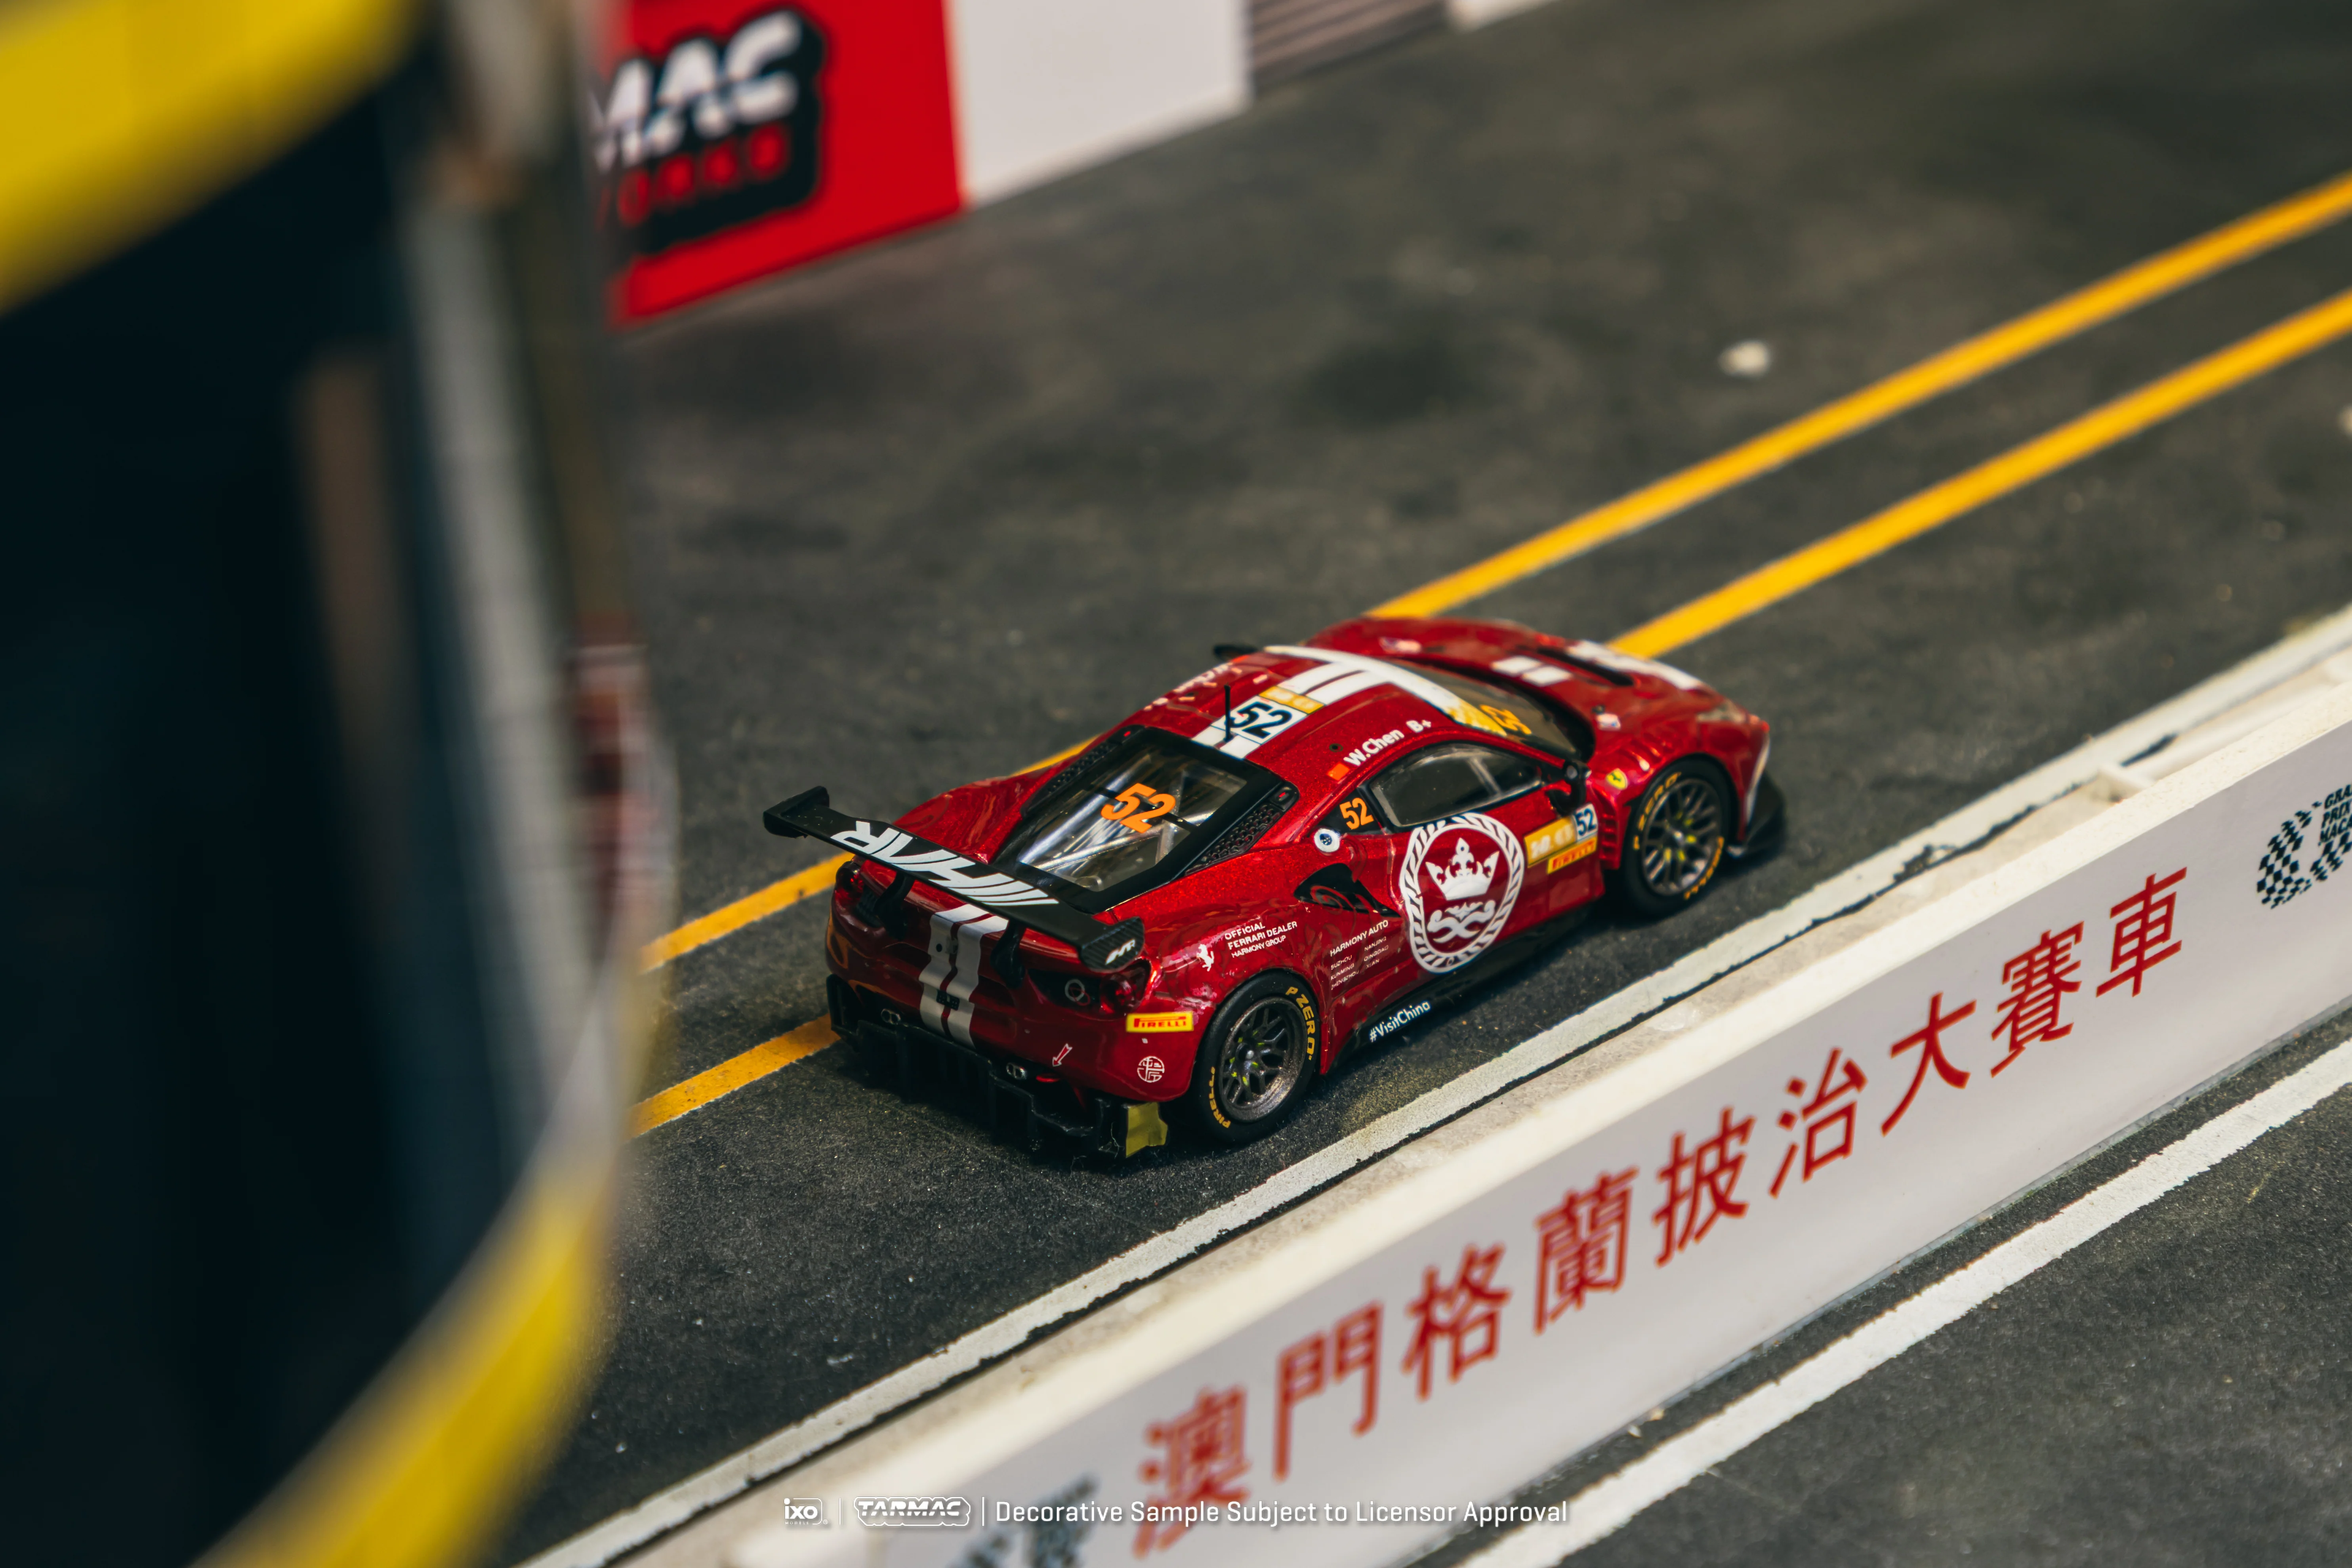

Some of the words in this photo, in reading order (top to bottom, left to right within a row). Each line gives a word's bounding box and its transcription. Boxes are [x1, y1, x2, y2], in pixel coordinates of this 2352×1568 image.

[1224, 701, 1292, 739] 52
[1343, 729, 1404, 766] W.Chen
[1101, 782, 1176, 834] 52
[1339, 797, 1374, 830] 52
[1574, 808, 1597, 836] 52
[1225, 922, 1265, 940] OFFICIAL
[1228, 932, 1266, 950] FERRARI
[1266, 921, 1297, 937] DEALER
[1330, 931, 1367, 957] HARMONY
[1368, 920, 1388, 936] AUTO
[1364, 936, 1387, 951] NANJING
[1231, 942, 1265, 958] HARMONY
[1265, 935, 1286, 947] GROUP
[1364, 945, 1389, 961] QINGDAO
[1331, 955, 1352, 970] SUZHOU
[1331, 963, 1354, 980] KUNMING
[1133, 1016, 1186, 1028] PIRELLI
[1296, 994, 1316, 1055] ZERO
[1370, 1001, 1431, 1043] #VisitChina
[1209, 1066, 1231, 1128] PIRELLI
